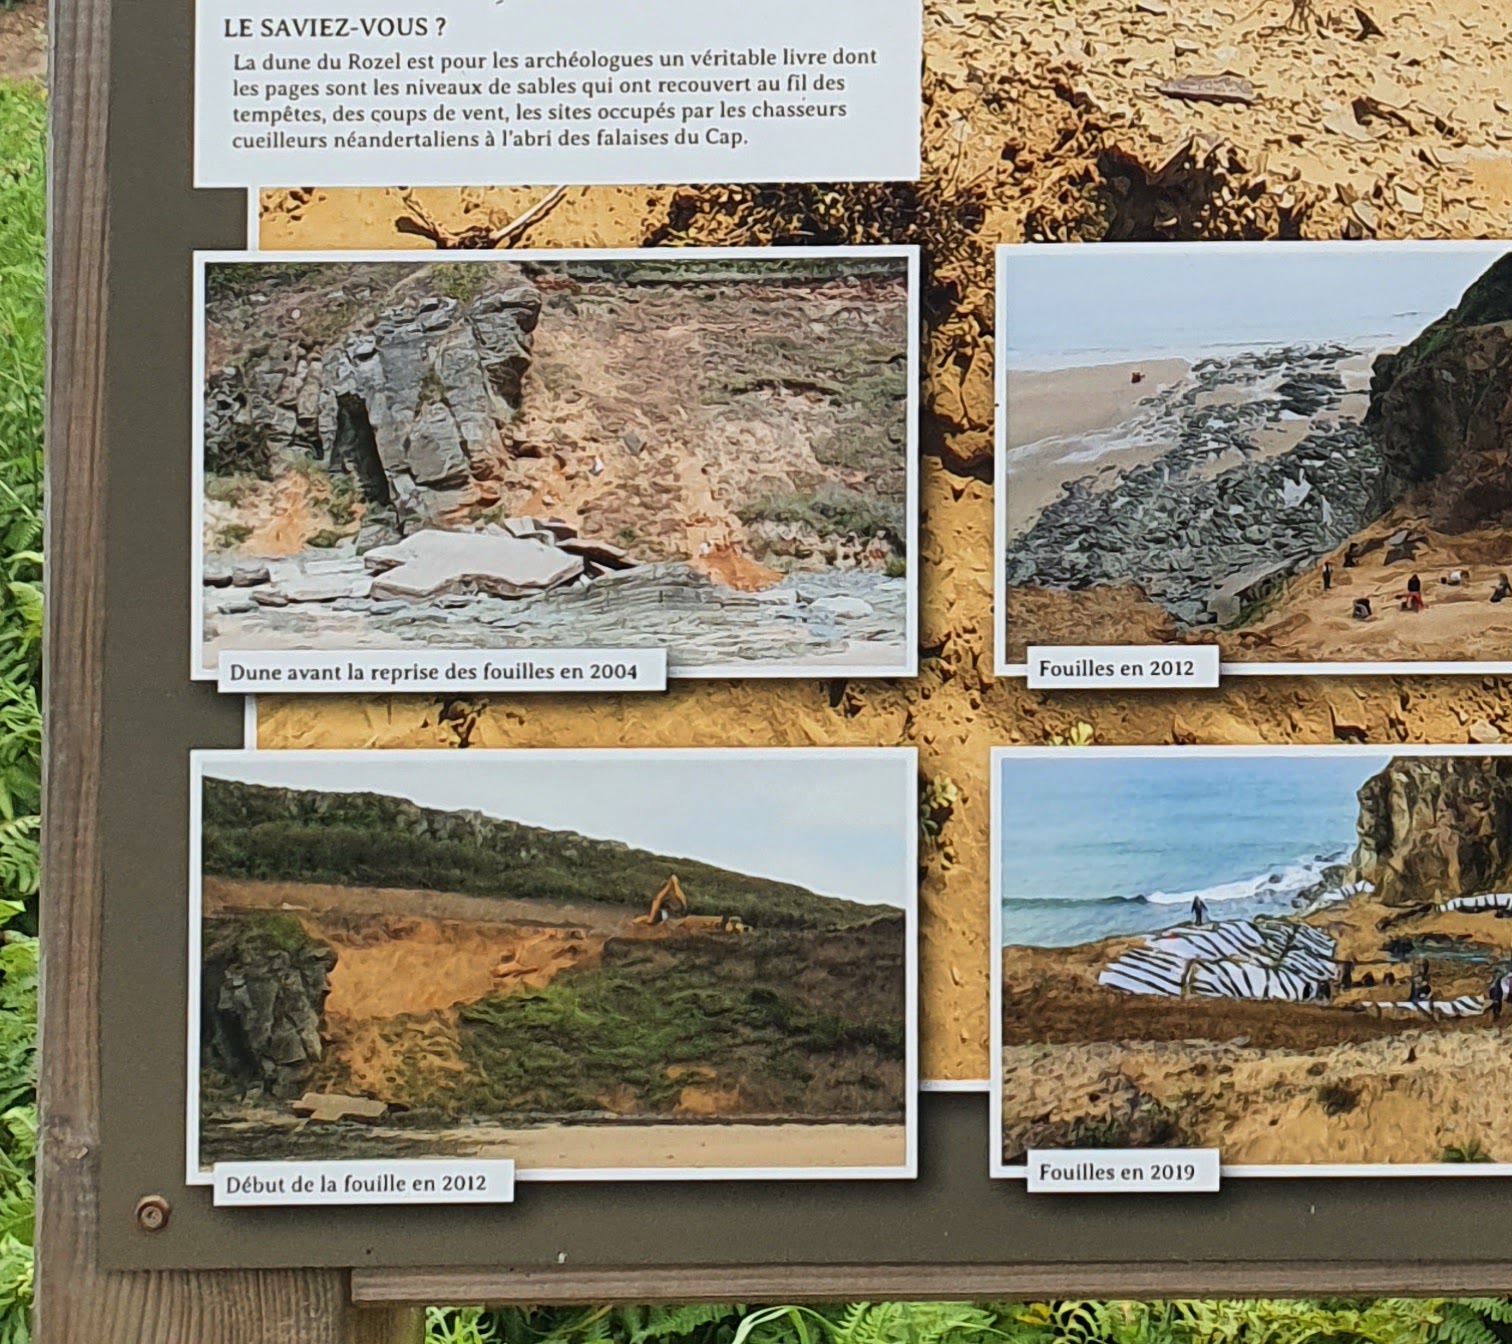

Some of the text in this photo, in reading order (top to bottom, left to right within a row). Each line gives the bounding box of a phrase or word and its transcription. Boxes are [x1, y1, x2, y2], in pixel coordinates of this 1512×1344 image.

[224, 18, 252, 37] LE
[260, 17, 427, 37] SAVIEZ-VOUS
[230, 661, 637, 684] Dune avant la reprise des fouilles en 2004
[1039, 658, 1194, 677] Fouilles en 2012
[1040, 1162, 1194, 1180] Fouilles en 2019
[226, 1173, 486, 1193] Début de la fouille en 2012
